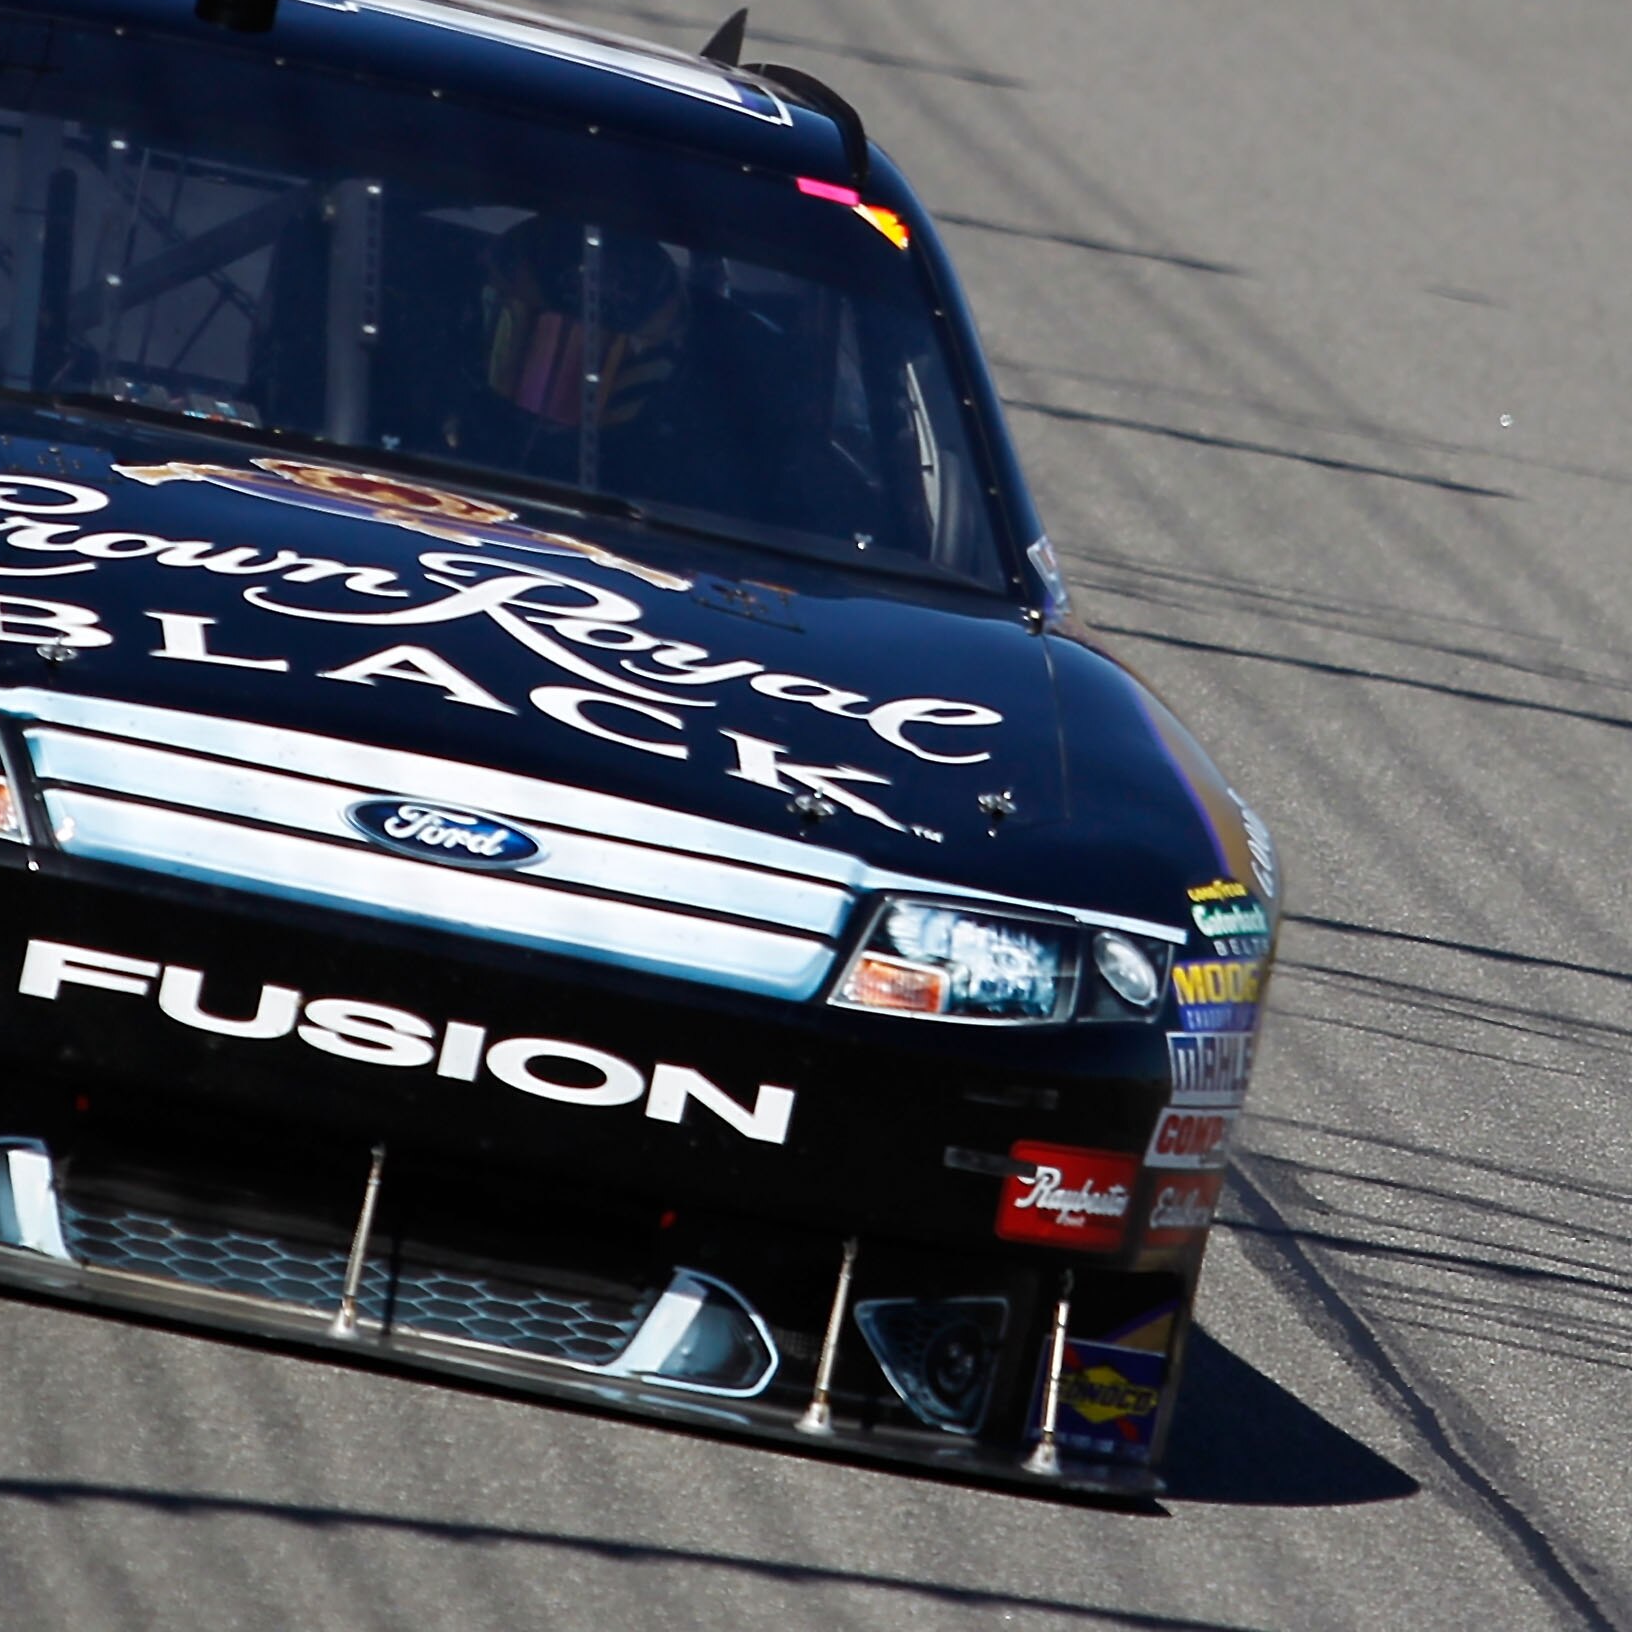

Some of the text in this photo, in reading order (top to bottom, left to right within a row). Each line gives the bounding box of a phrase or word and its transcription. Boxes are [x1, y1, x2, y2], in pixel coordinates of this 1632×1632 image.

[243, 551, 1003, 764] Royal
[383, 804, 510, 857] Ford
[17, 938, 796, 1145] FUSION
[1155, 1114, 1226, 1156] COMP
